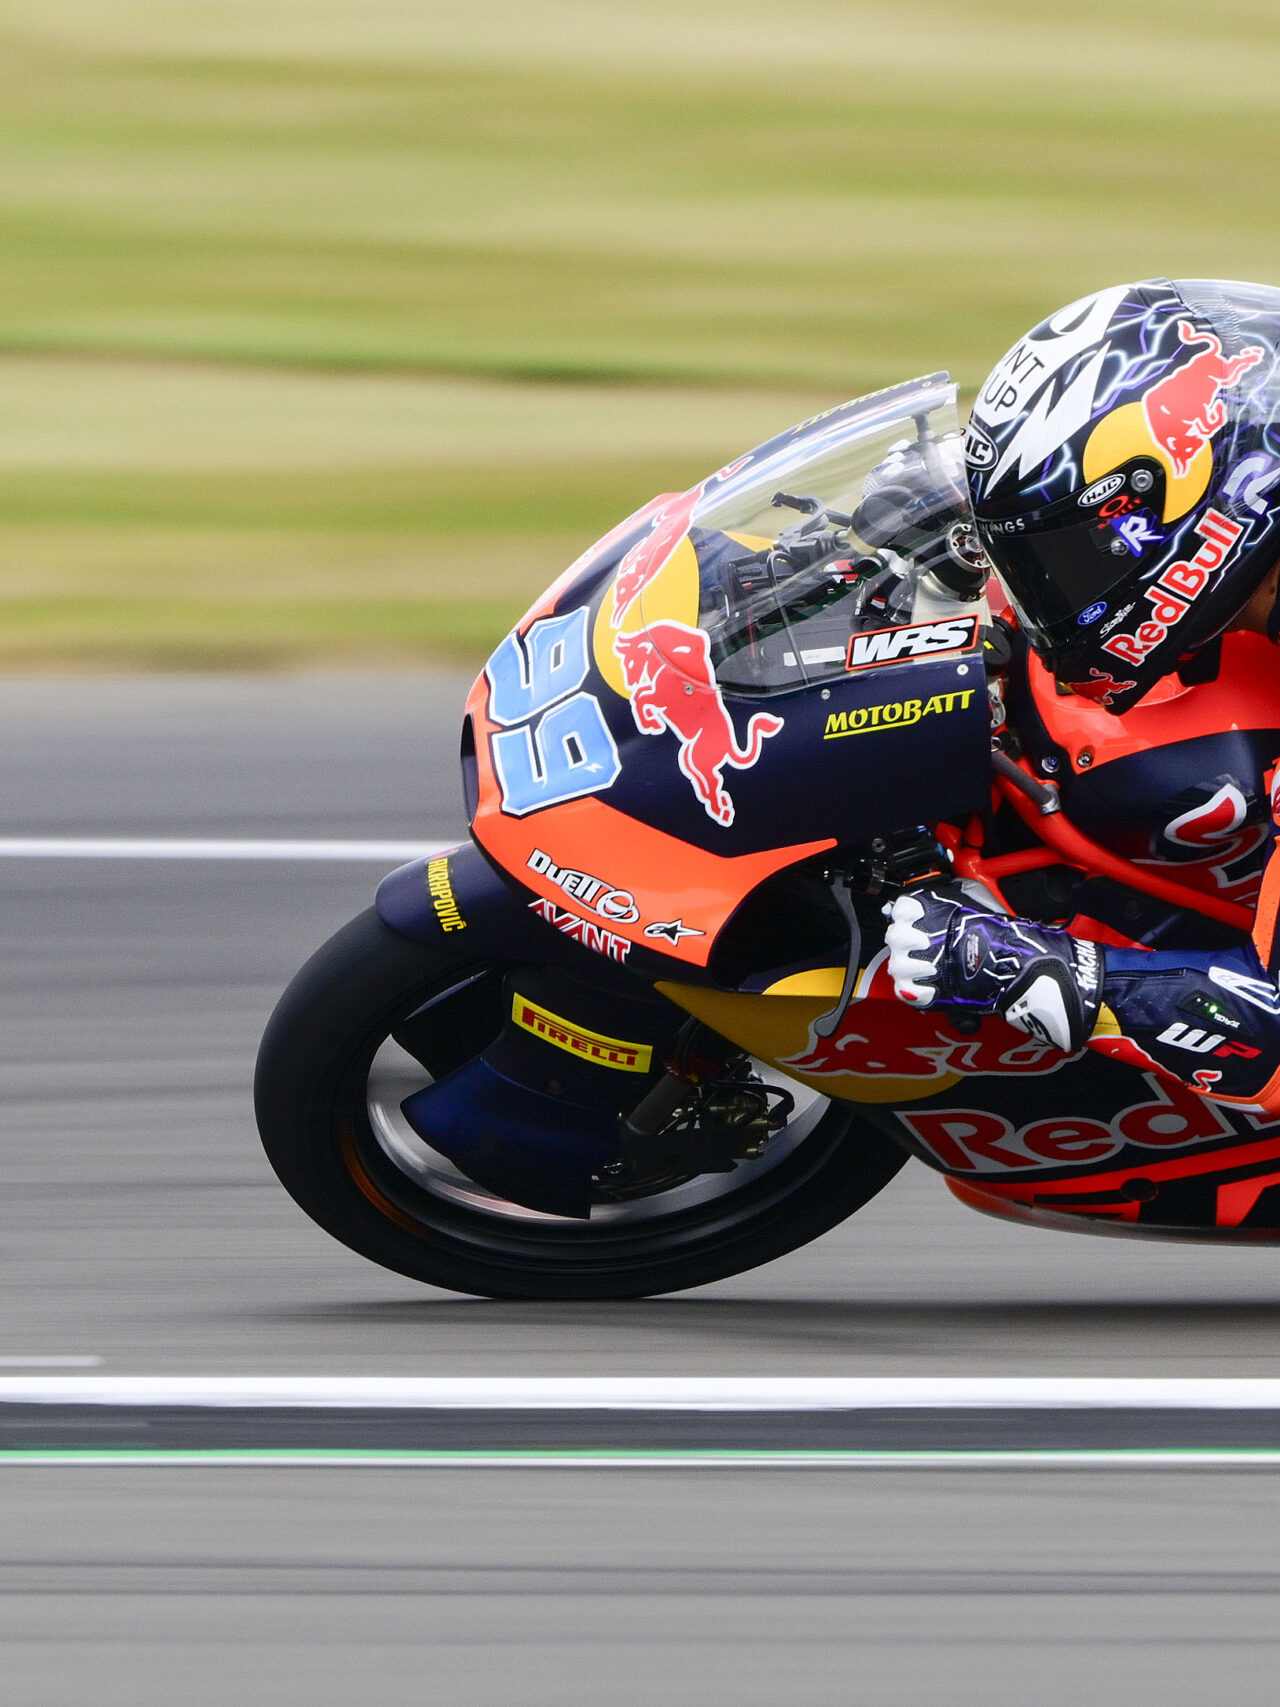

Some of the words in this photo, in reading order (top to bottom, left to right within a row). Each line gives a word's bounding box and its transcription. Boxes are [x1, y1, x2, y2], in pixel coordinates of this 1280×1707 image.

[1084, 477, 1124, 505] HJC
[1101, 588, 1191, 667] Red
[1163, 508, 1245, 600] Bull
[1082, 605, 1103, 623] Ford
[850, 617, 977, 666] WRS
[824, 690, 976, 739] MOTOBATT
[521, 1005, 639, 1066] PIRELLI
[893, 1070, 1240, 1174] Red
